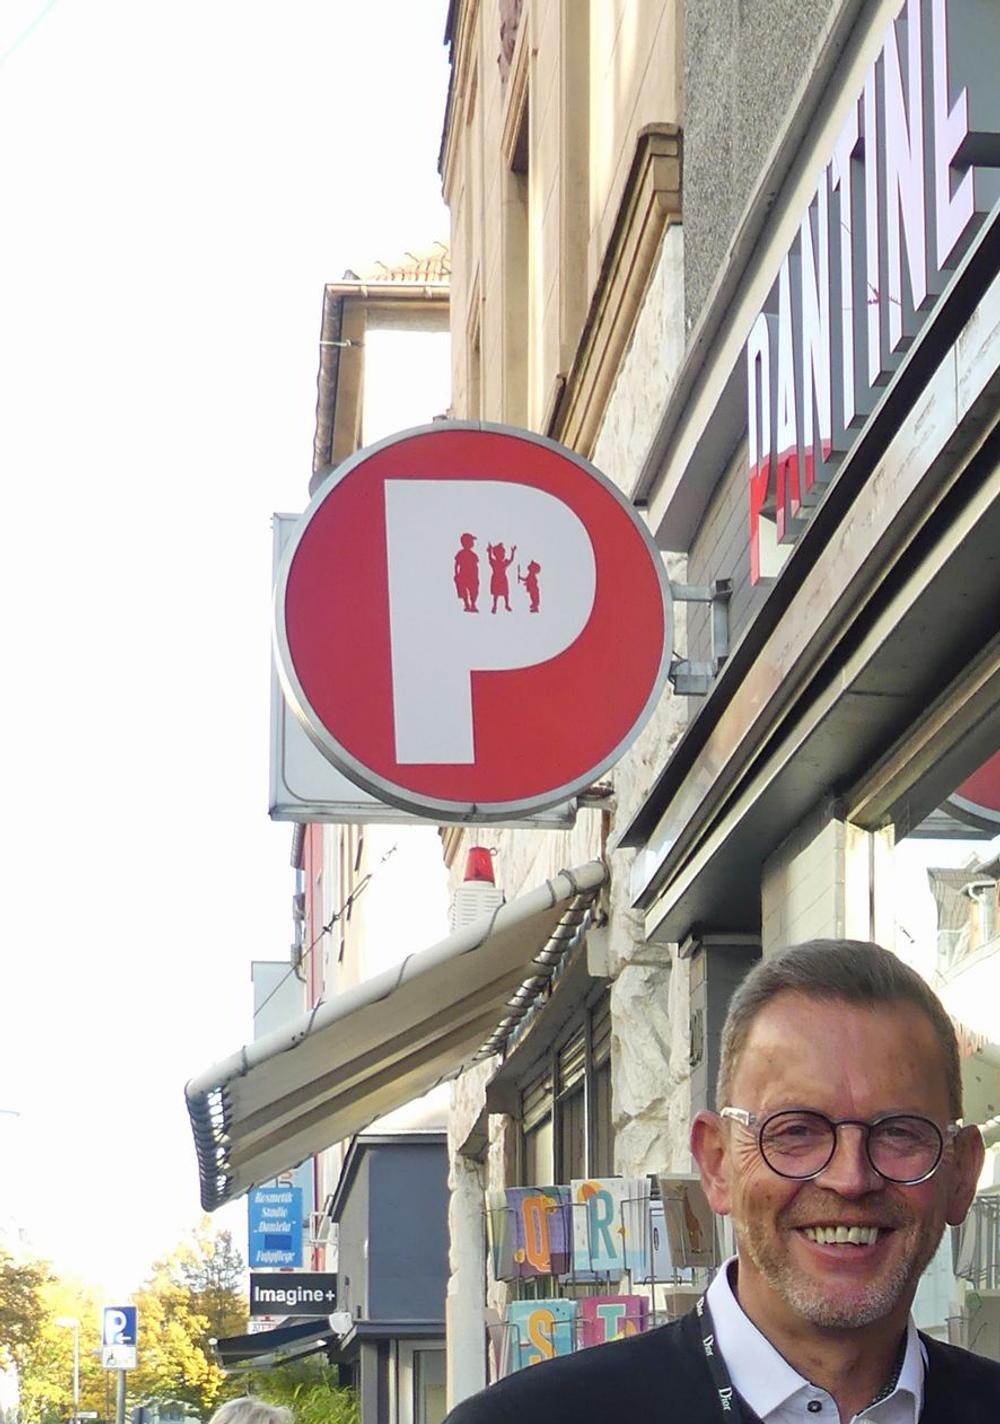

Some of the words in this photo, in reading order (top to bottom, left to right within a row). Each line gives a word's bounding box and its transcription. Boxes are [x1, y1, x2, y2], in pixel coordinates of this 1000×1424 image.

[384, 479, 597, 764] P
[589, 1188, 618, 1259] R
[718, 1386, 732, 1411] Dior
